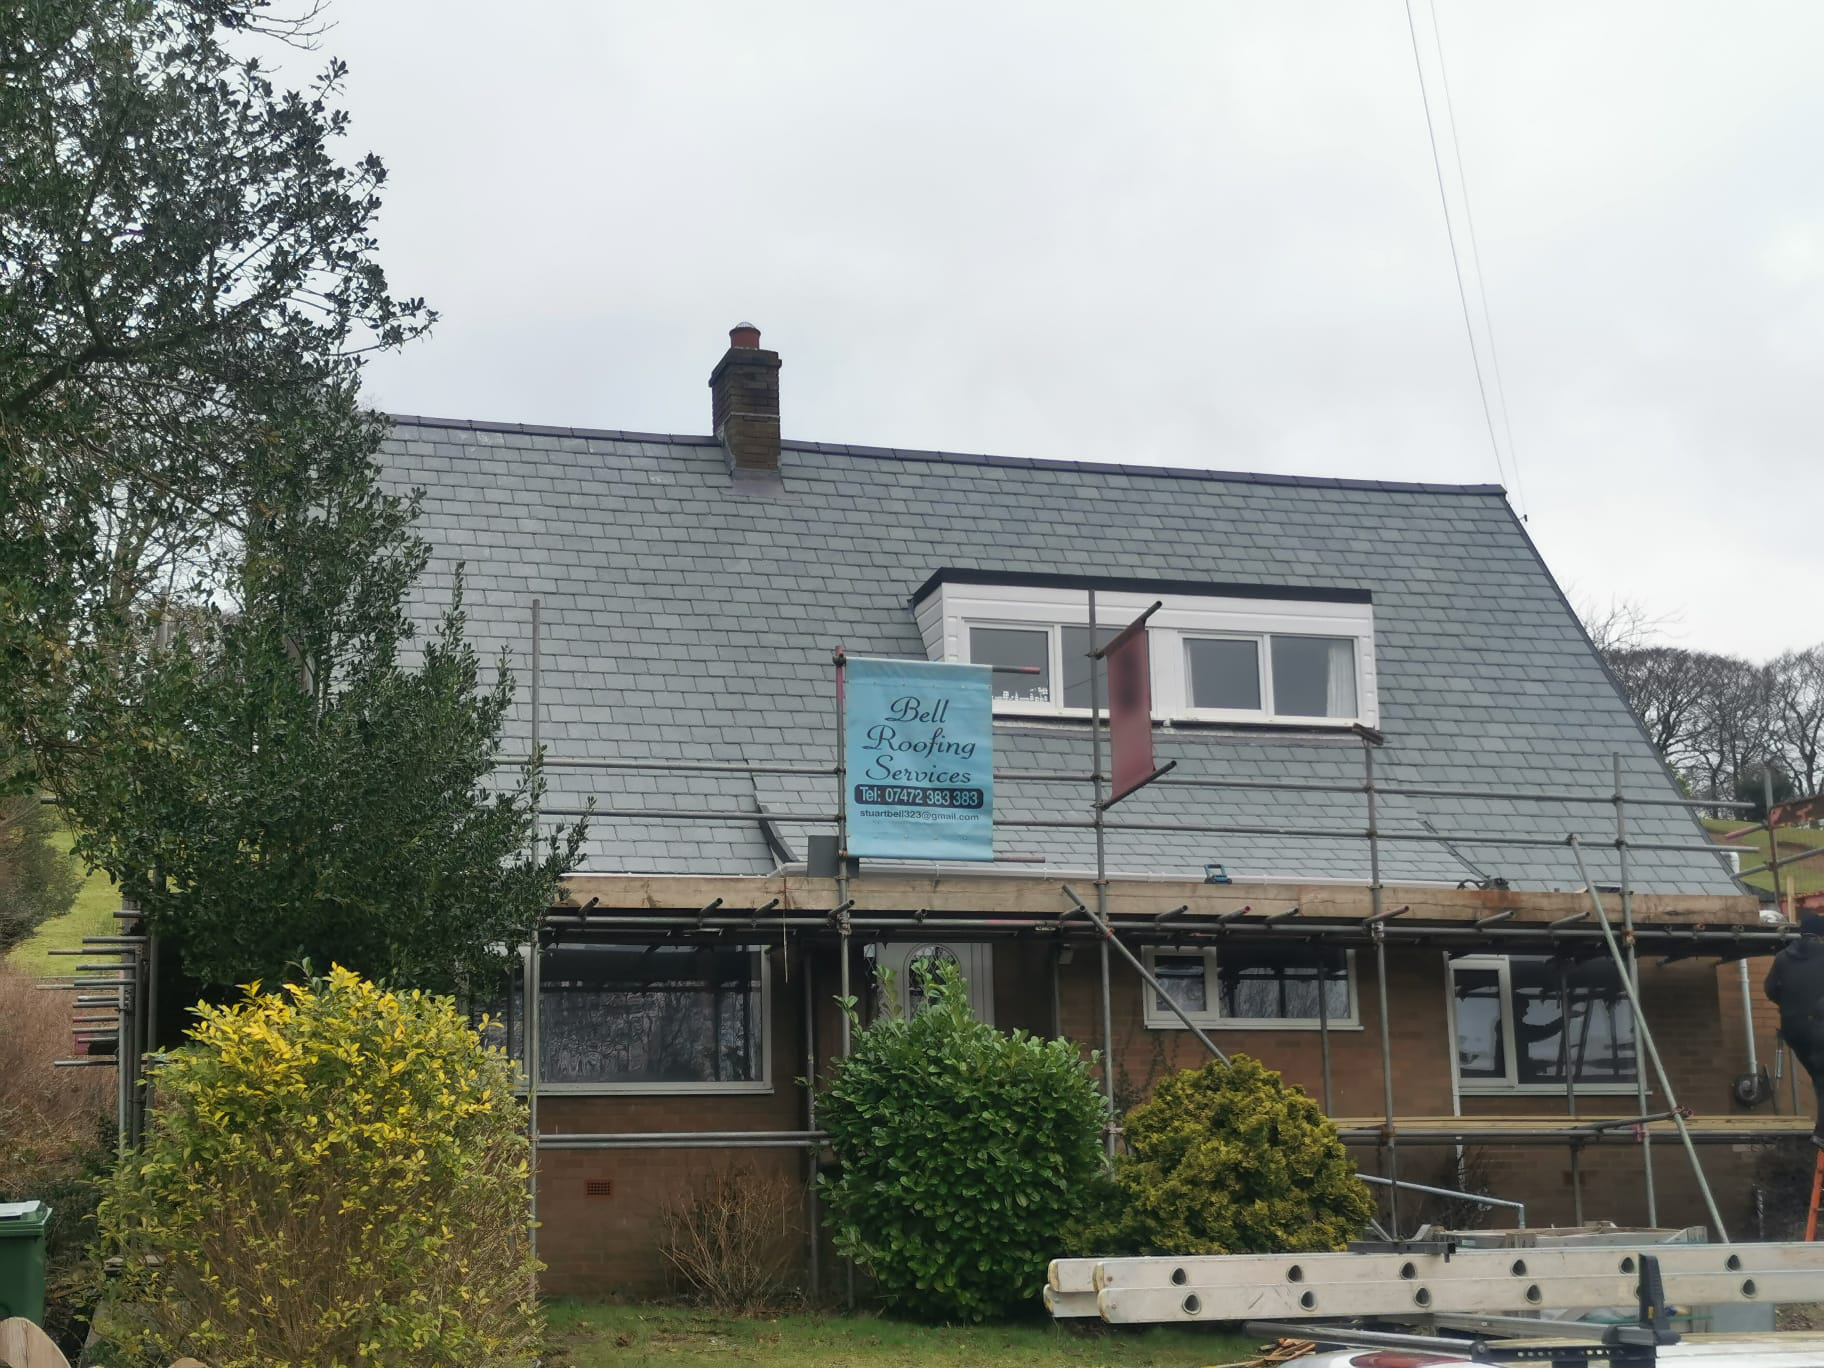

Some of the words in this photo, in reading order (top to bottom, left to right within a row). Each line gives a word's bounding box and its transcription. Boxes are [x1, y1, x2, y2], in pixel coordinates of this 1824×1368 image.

[885, 696, 949, 723] Bell
[862, 724, 976, 759] Roofing
[866, 754, 971, 783] Services
[860, 787, 881, 802] Tel:
[885, 788, 923, 804] 07472
[926, 790, 951, 806] 383
[952, 791, 978, 806] 383
